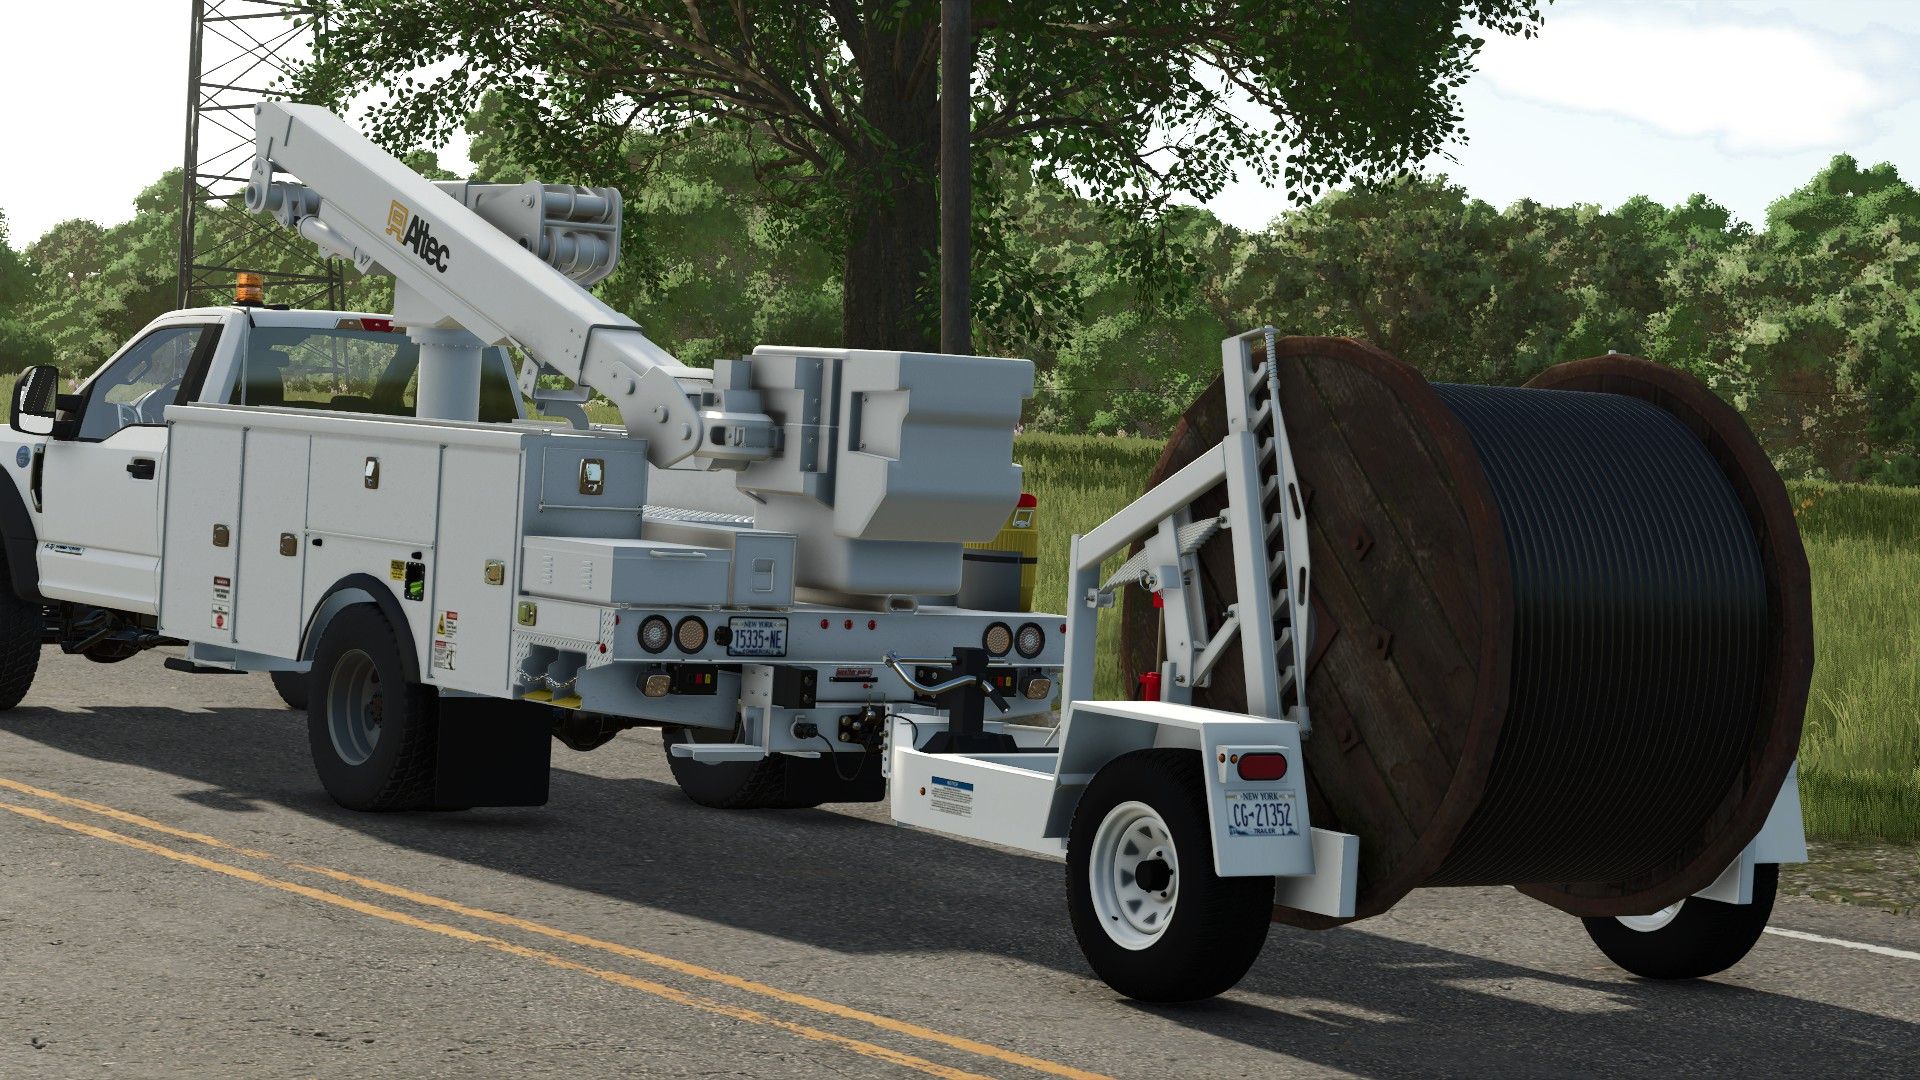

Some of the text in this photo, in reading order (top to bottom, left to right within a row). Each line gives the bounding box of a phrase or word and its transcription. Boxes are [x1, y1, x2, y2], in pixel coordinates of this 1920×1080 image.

[402, 214, 450, 273] Altec
[1243, 792, 1279, 800] NEW YORK
[1234, 803, 1292, 827] CG-21352
